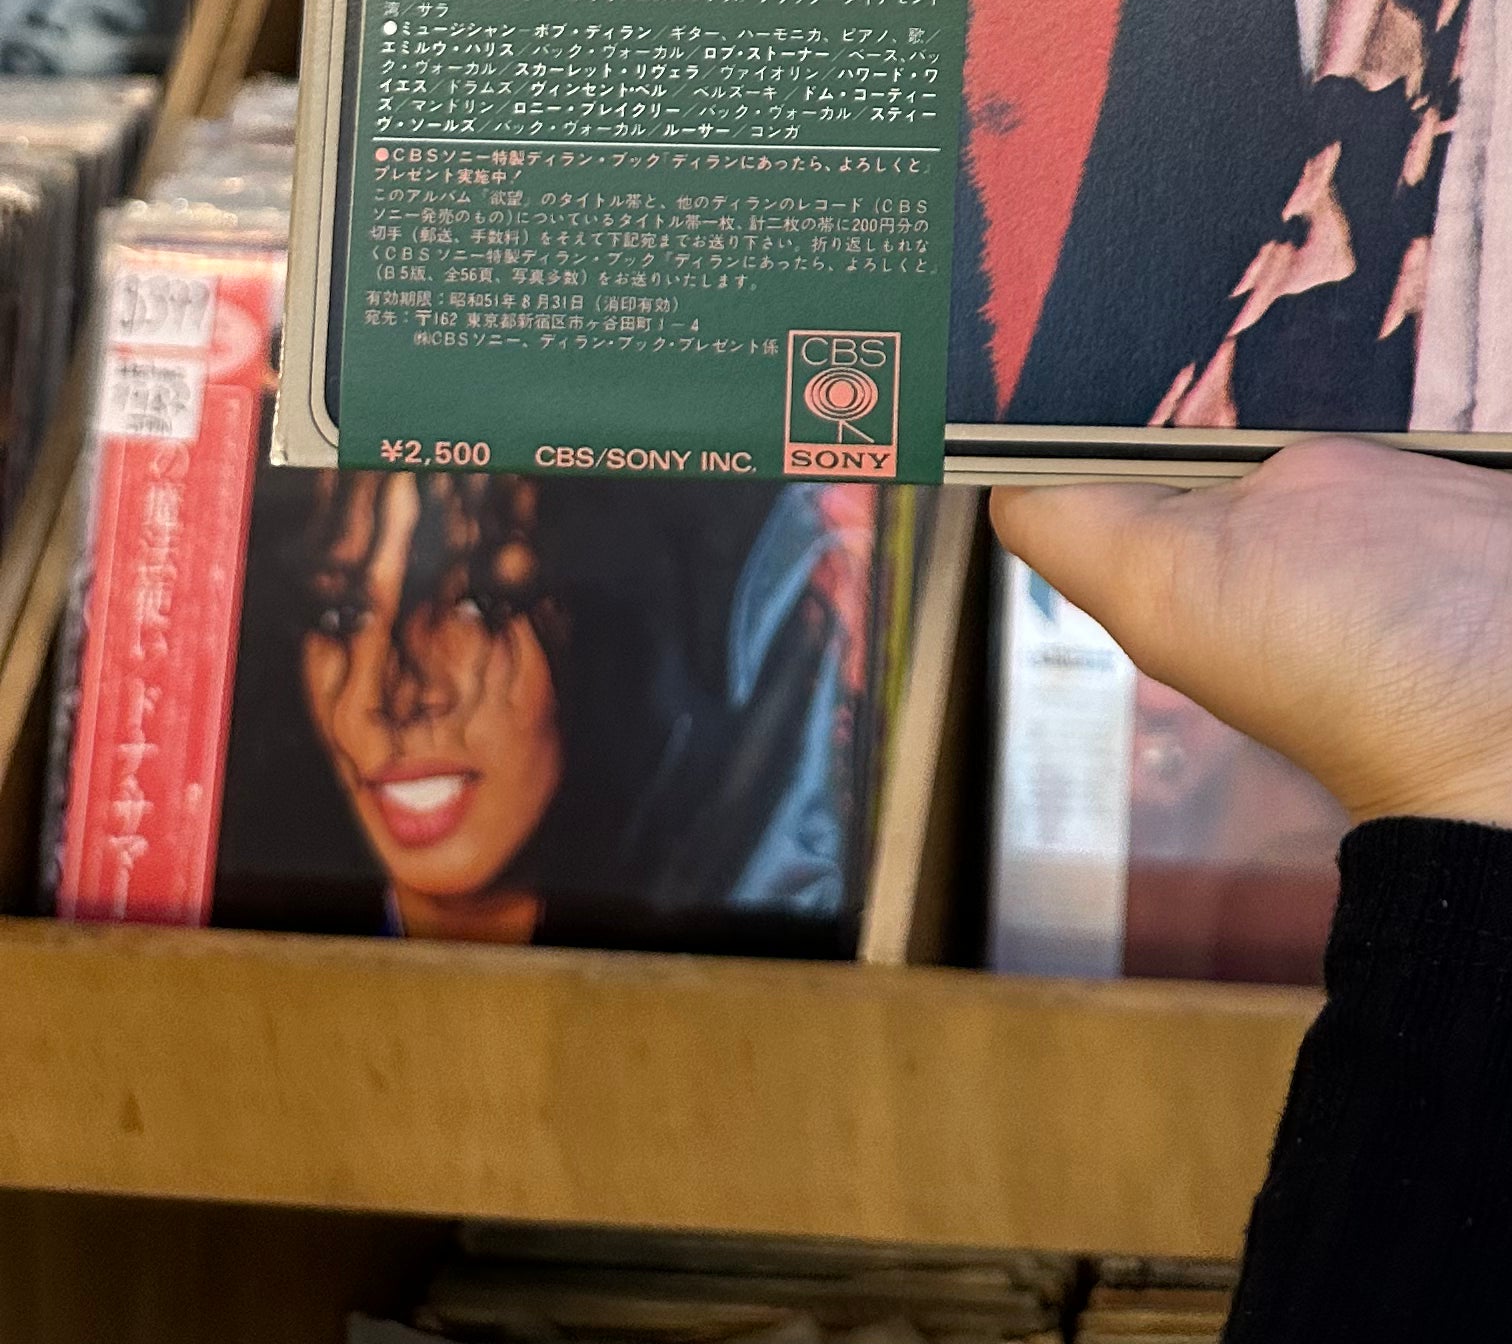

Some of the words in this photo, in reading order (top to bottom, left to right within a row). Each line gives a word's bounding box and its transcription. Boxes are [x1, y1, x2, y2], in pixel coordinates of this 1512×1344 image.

[800, 336, 887, 367] CBS
[380, 439, 491, 468] ¥2,500
[534, 445, 691, 472] CBS/SONY
[701, 450, 757, 474] INC.
[790, 449, 892, 470] SONY
